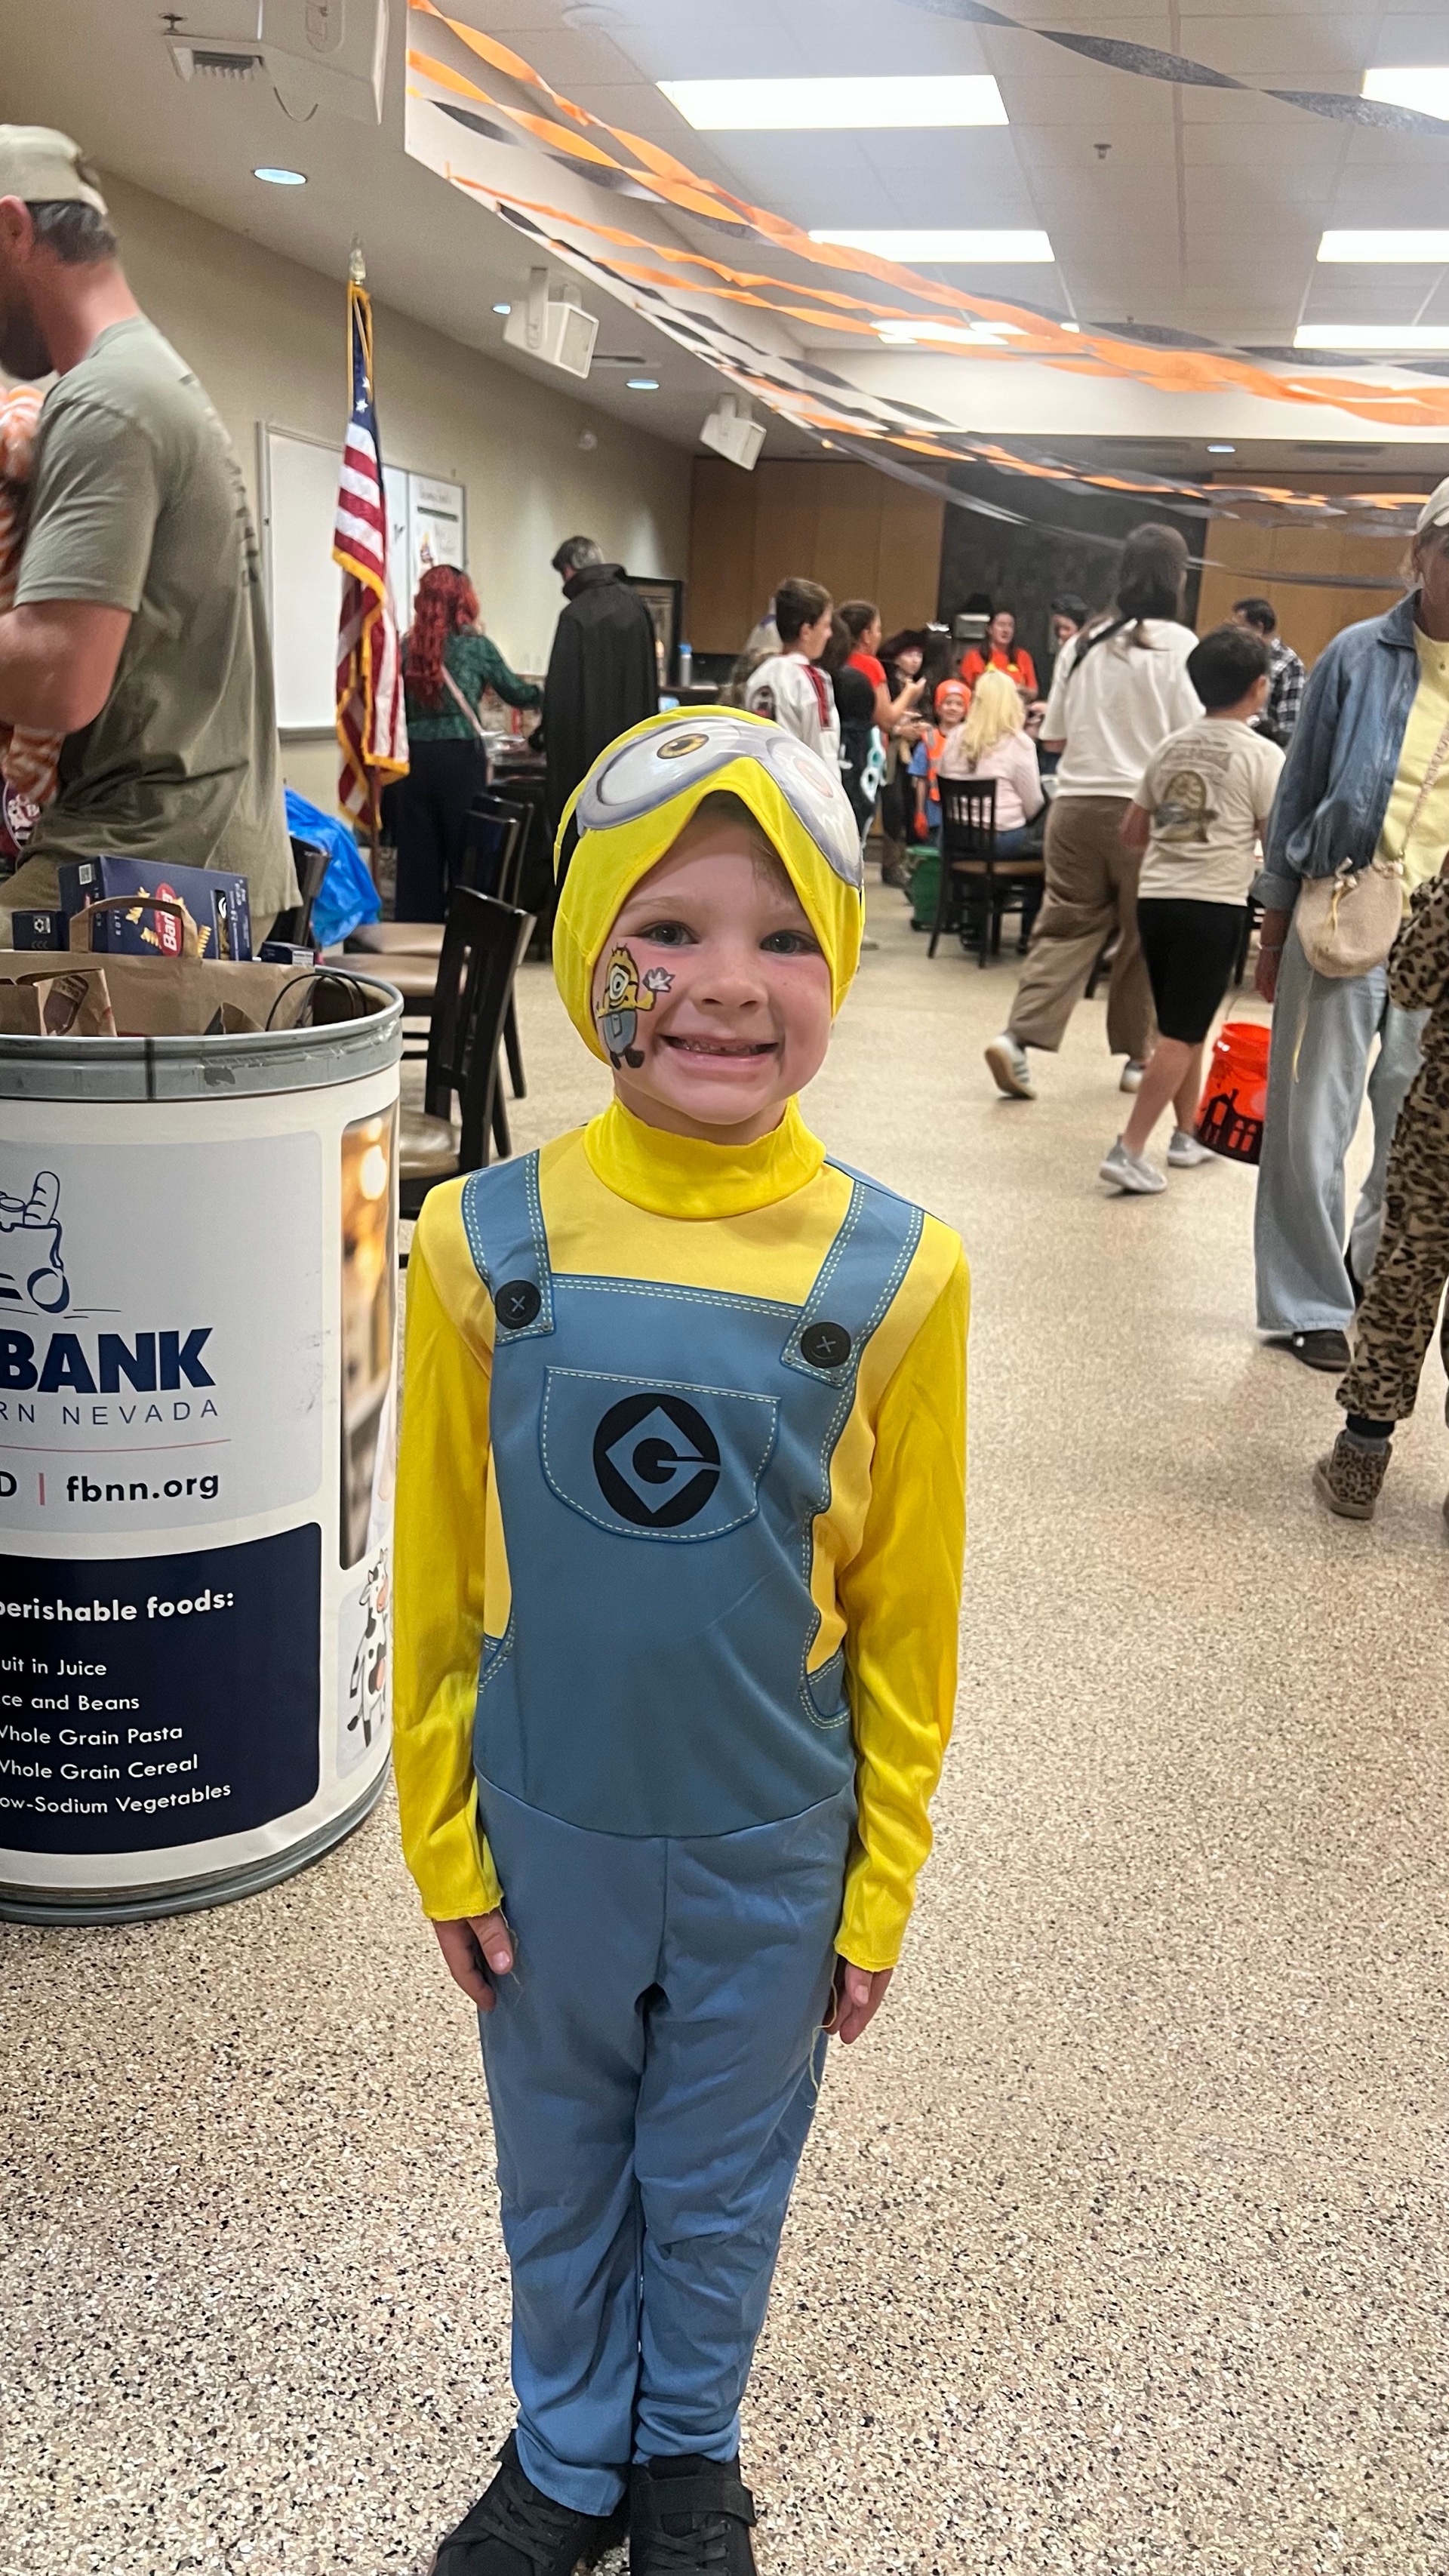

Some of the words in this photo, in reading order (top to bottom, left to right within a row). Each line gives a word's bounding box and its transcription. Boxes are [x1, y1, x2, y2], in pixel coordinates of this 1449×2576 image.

[160, 893, 177, 951] Baria
[0, 1328, 216, 1393] BANK
[63, 1399, 218, 1425] NEVADA
[66, 1475, 218, 1502] fbnn.org
[147, 1590, 234, 1619] foods:
[32, 1658, 48, 1674] in
[57, 1659, 107, 1676] Juice
[0, 1695, 23, 1707] ce
[31, 1694, 69, 1710] and
[78, 1695, 140, 1710] Beans
[59, 1729, 118, 1745] Grain
[128, 1728, 183, 1743] Pasta
[60, 1765, 120, 1780] Grain
[128, 1753, 198, 1778] Cereal
[115, 1785, 231, 1814] Vegetables
